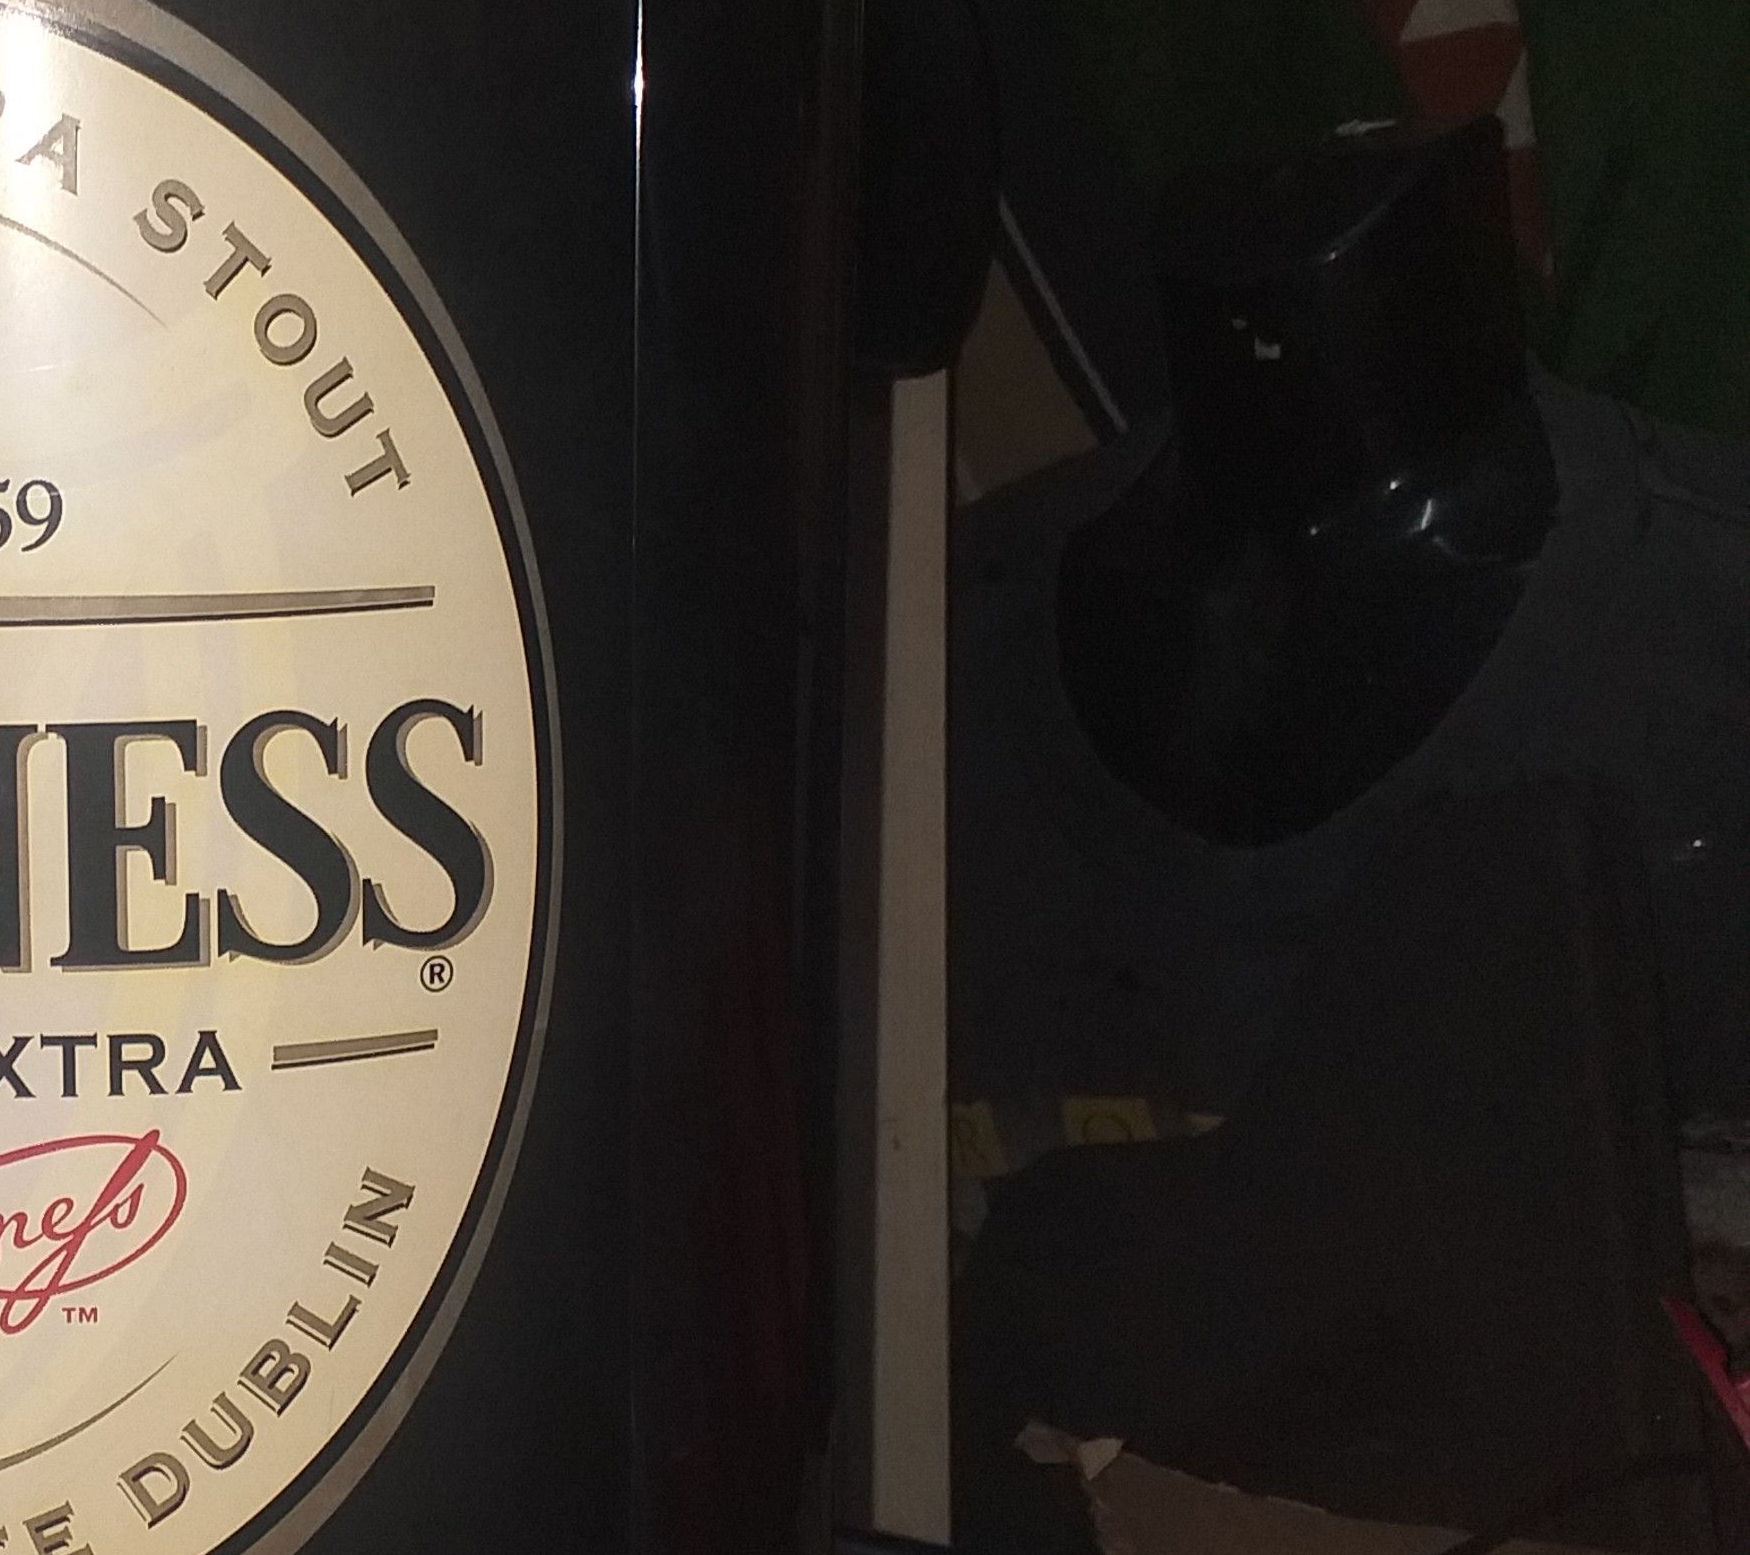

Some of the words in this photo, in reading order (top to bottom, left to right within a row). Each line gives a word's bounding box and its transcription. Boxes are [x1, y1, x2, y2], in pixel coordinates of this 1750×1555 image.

[133, 179, 410, 496] STOUT
[62, 1306, 99, 1324] TM
[117, 1166, 416, 1528] DUBLIN
